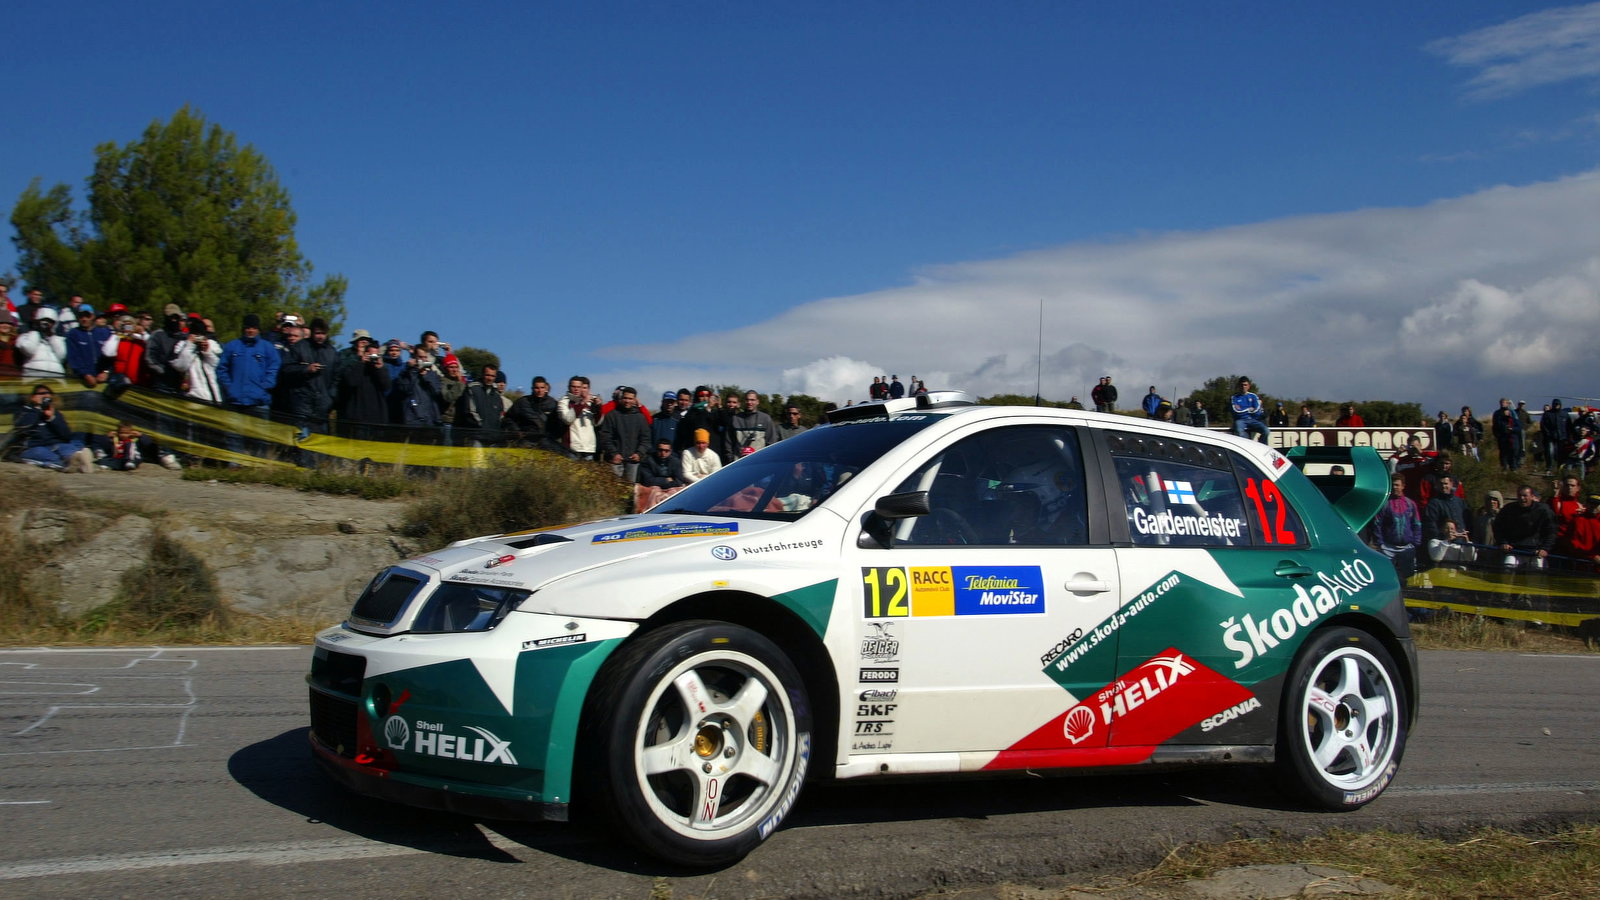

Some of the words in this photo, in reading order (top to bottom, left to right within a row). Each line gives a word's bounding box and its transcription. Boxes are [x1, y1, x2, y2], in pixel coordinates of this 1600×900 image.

[1133, 507, 1241, 538] Gardemeister
[1245, 477, 1297, 545] 12
[744, 538, 824, 555] Nutzfahrzeuge
[913, 571, 949, 584] RACC
[864, 567, 908, 617] 12
[980, 591, 1038, 606] MoviStar
[1056, 573, 1181, 672] www.skoda-auto.com
[538, 634, 585, 646] MICHELIN
[1040, 627, 1084, 667] RECARO
[862, 671, 897, 680] FERODO
[859, 689, 898, 702] Eibach
[1099, 654, 1196, 725] HELIX
[857, 704, 898, 716] SKF
[1200, 696, 1262, 732] SCANIA
[416, 720, 444, 732] Shell
[856, 720, 889, 733] TRS
[415, 726, 519, 765] HELIX
[763, 758, 807, 836] MICHELIN
